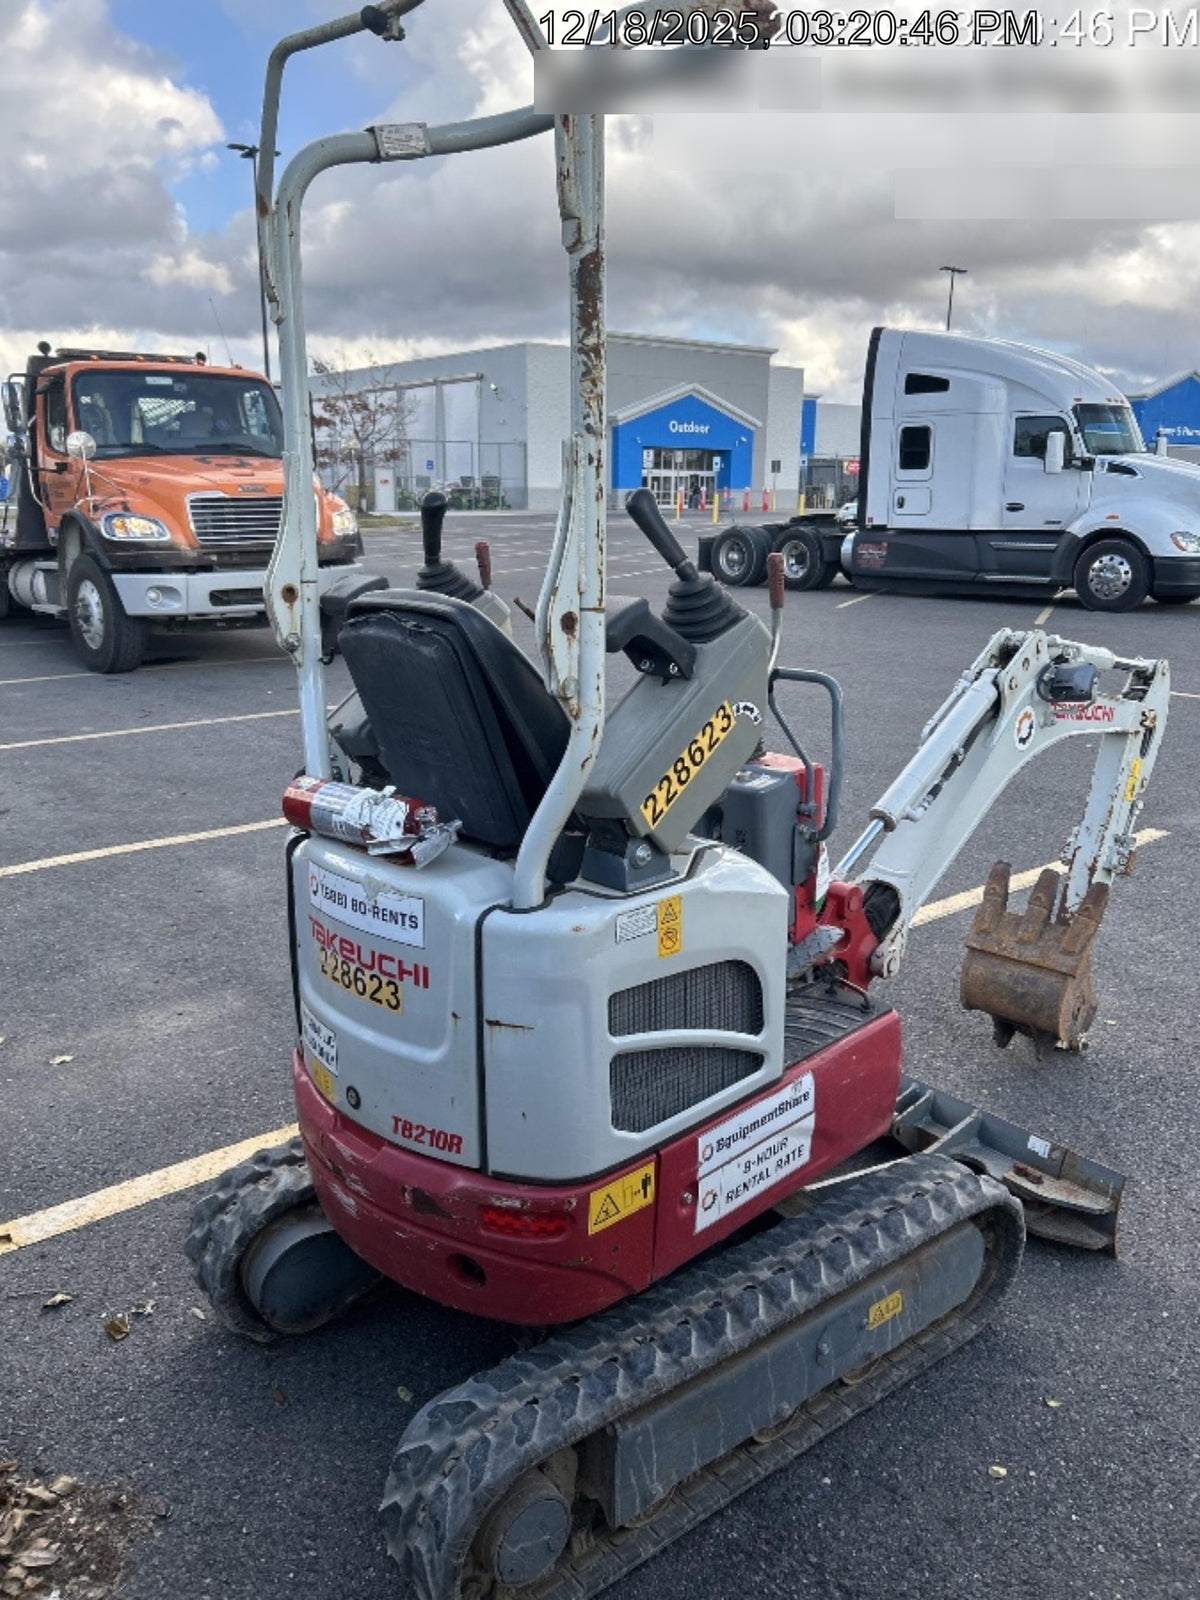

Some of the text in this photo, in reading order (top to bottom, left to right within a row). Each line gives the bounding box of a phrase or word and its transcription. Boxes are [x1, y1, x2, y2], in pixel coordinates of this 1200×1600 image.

[669, 420, 711, 434] Outdoor
[643, 704, 732, 826] 228623
[308, 914, 430, 990] TAKEUCHI
[320, 946, 401, 1010] 228623
[392, 1114, 464, 1155] TB210R
[715, 1090, 811, 1153] EquipmentShare
[725, 1144, 805, 1205] RENTAL RATE
[743, 1136, 789, 1175] 8-HOUR
